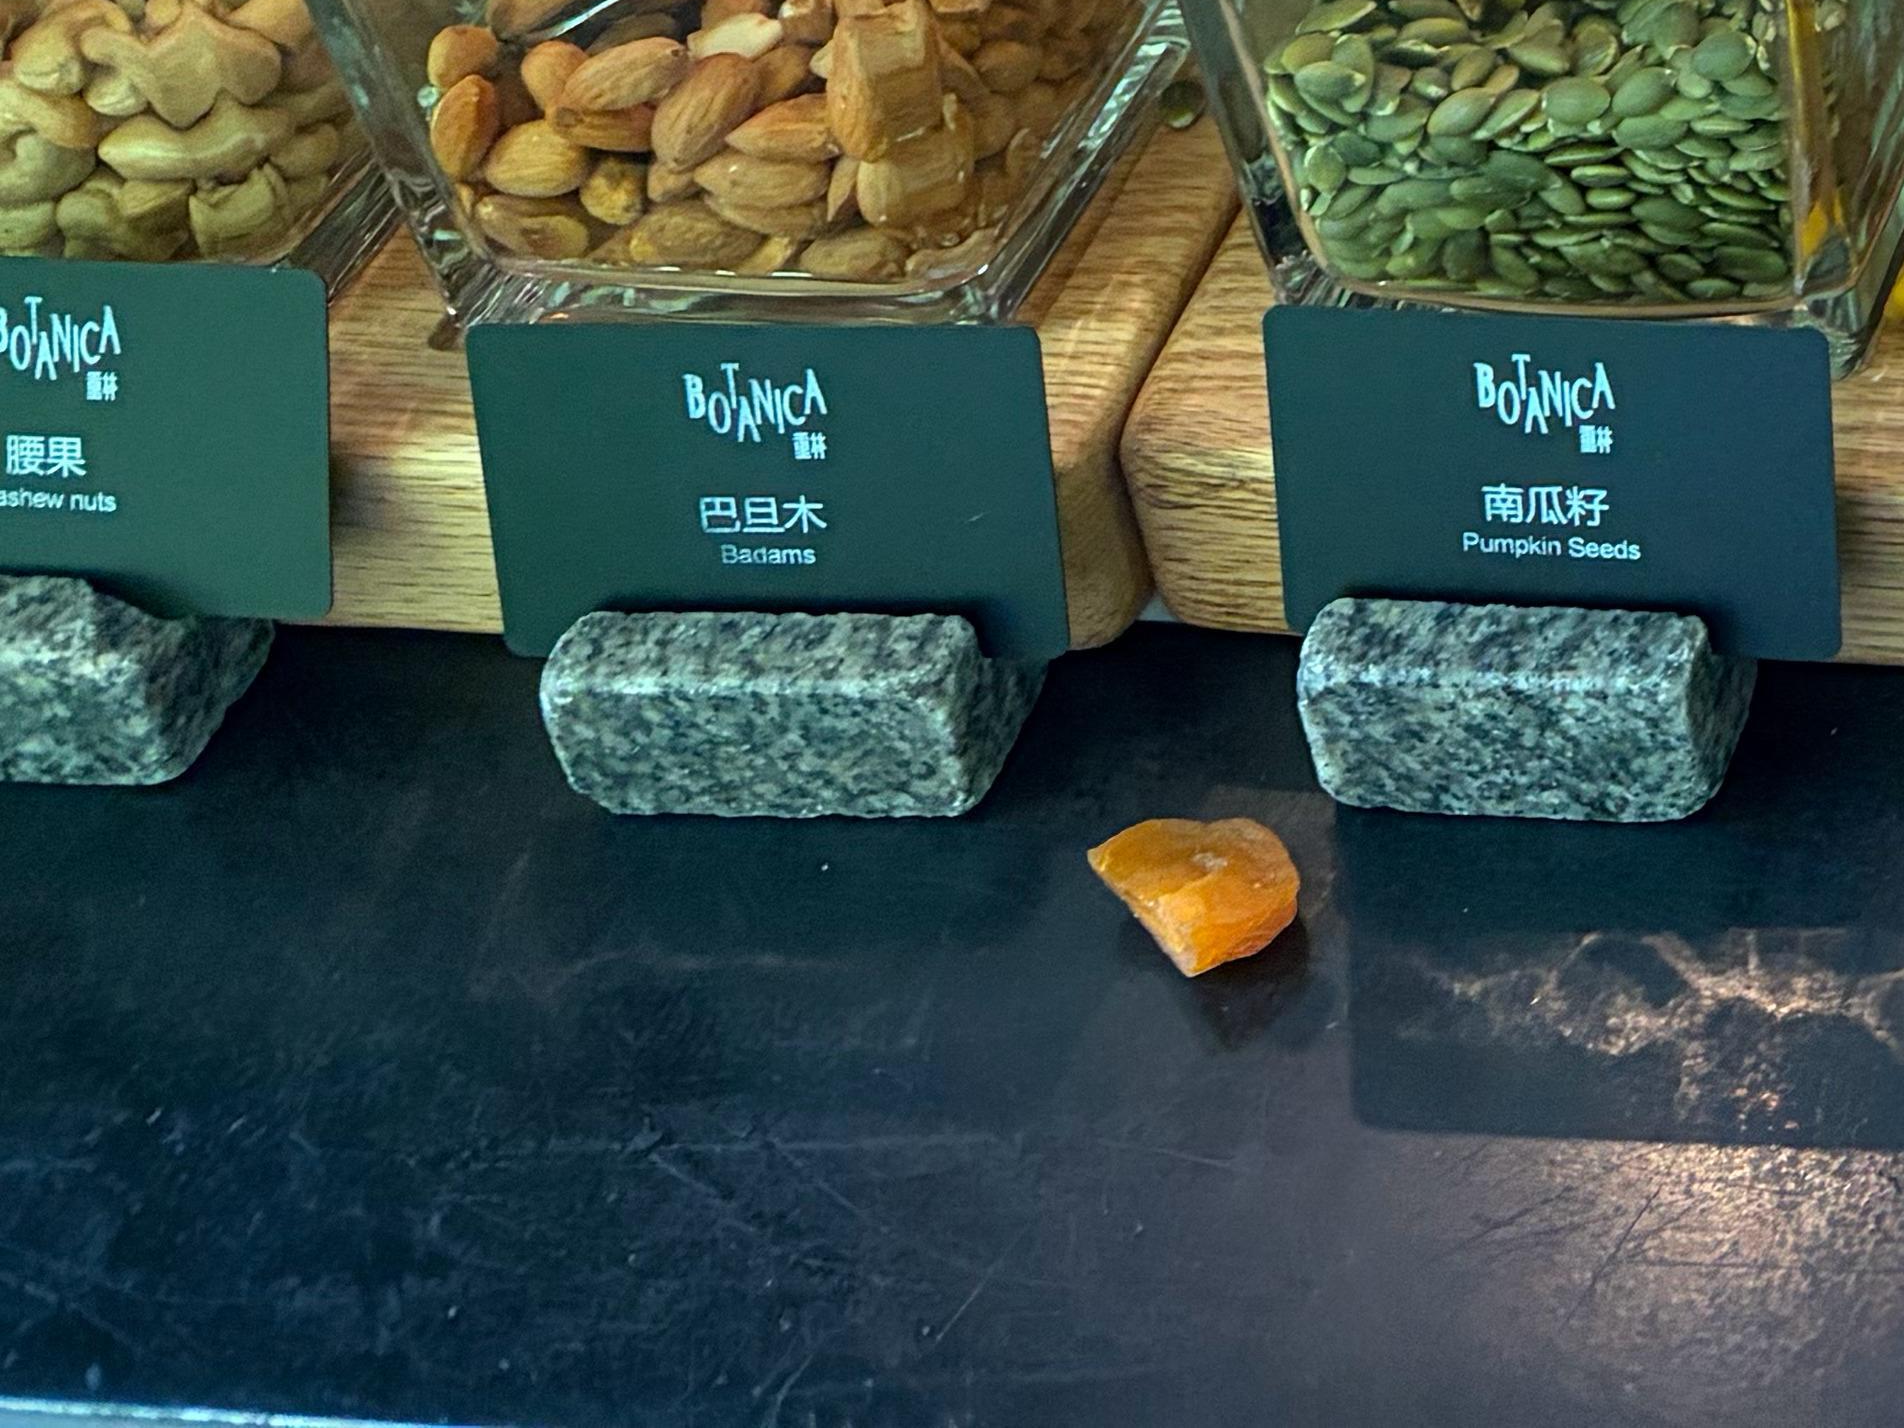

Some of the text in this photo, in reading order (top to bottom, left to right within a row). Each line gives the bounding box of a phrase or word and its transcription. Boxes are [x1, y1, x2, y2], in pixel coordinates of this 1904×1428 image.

[683, 363, 828, 442] BOTANICA
[1473, 354, 1615, 434] BOTANICA
[6, 435, 87, 478] 腰果
[70, 492, 117, 512] nuts
[700, 495, 827, 533] 巴旦木
[1481, 483, 1609, 527] 南瓜籽
[721, 544, 816, 564] Badams
[1462, 532, 1641, 560] Pumpkin Seeds
